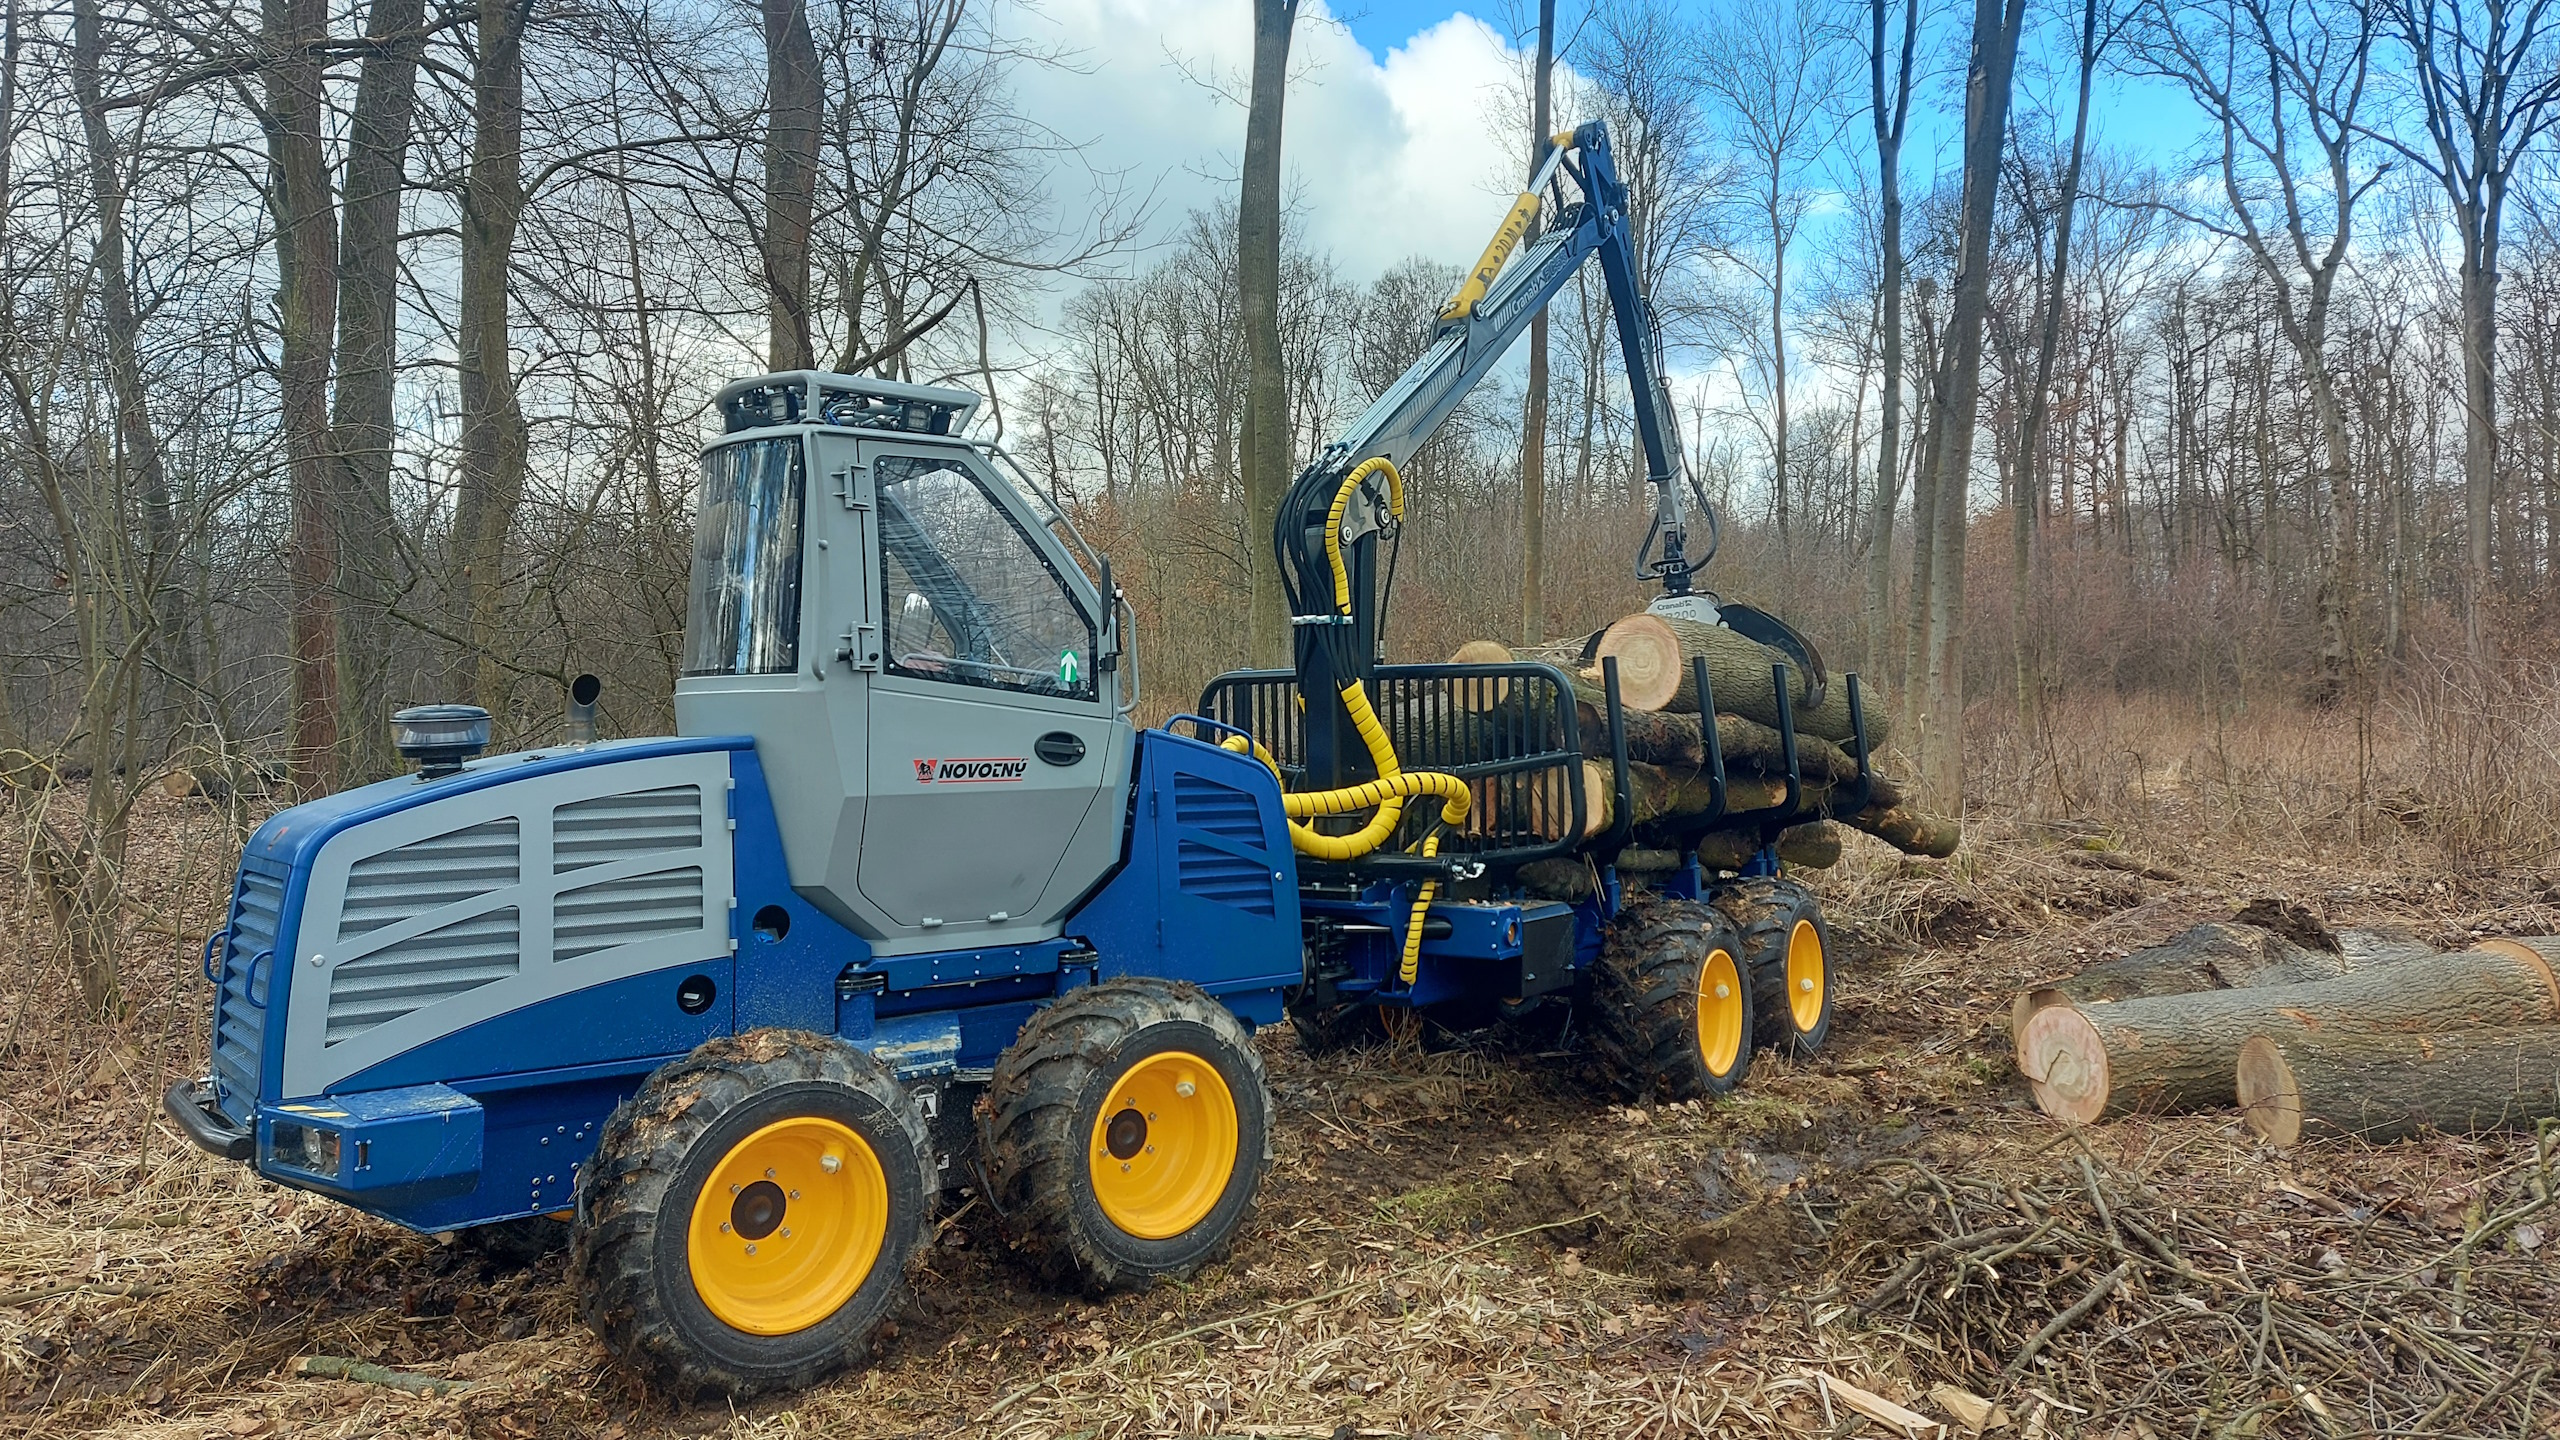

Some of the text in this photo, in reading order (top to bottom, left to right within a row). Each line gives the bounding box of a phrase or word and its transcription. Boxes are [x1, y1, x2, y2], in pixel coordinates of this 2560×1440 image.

[1511, 280, 1539, 315] Cranab
[1639, 337, 1654, 390] Cranab
[1657, 601, 1685, 610] Cranab
